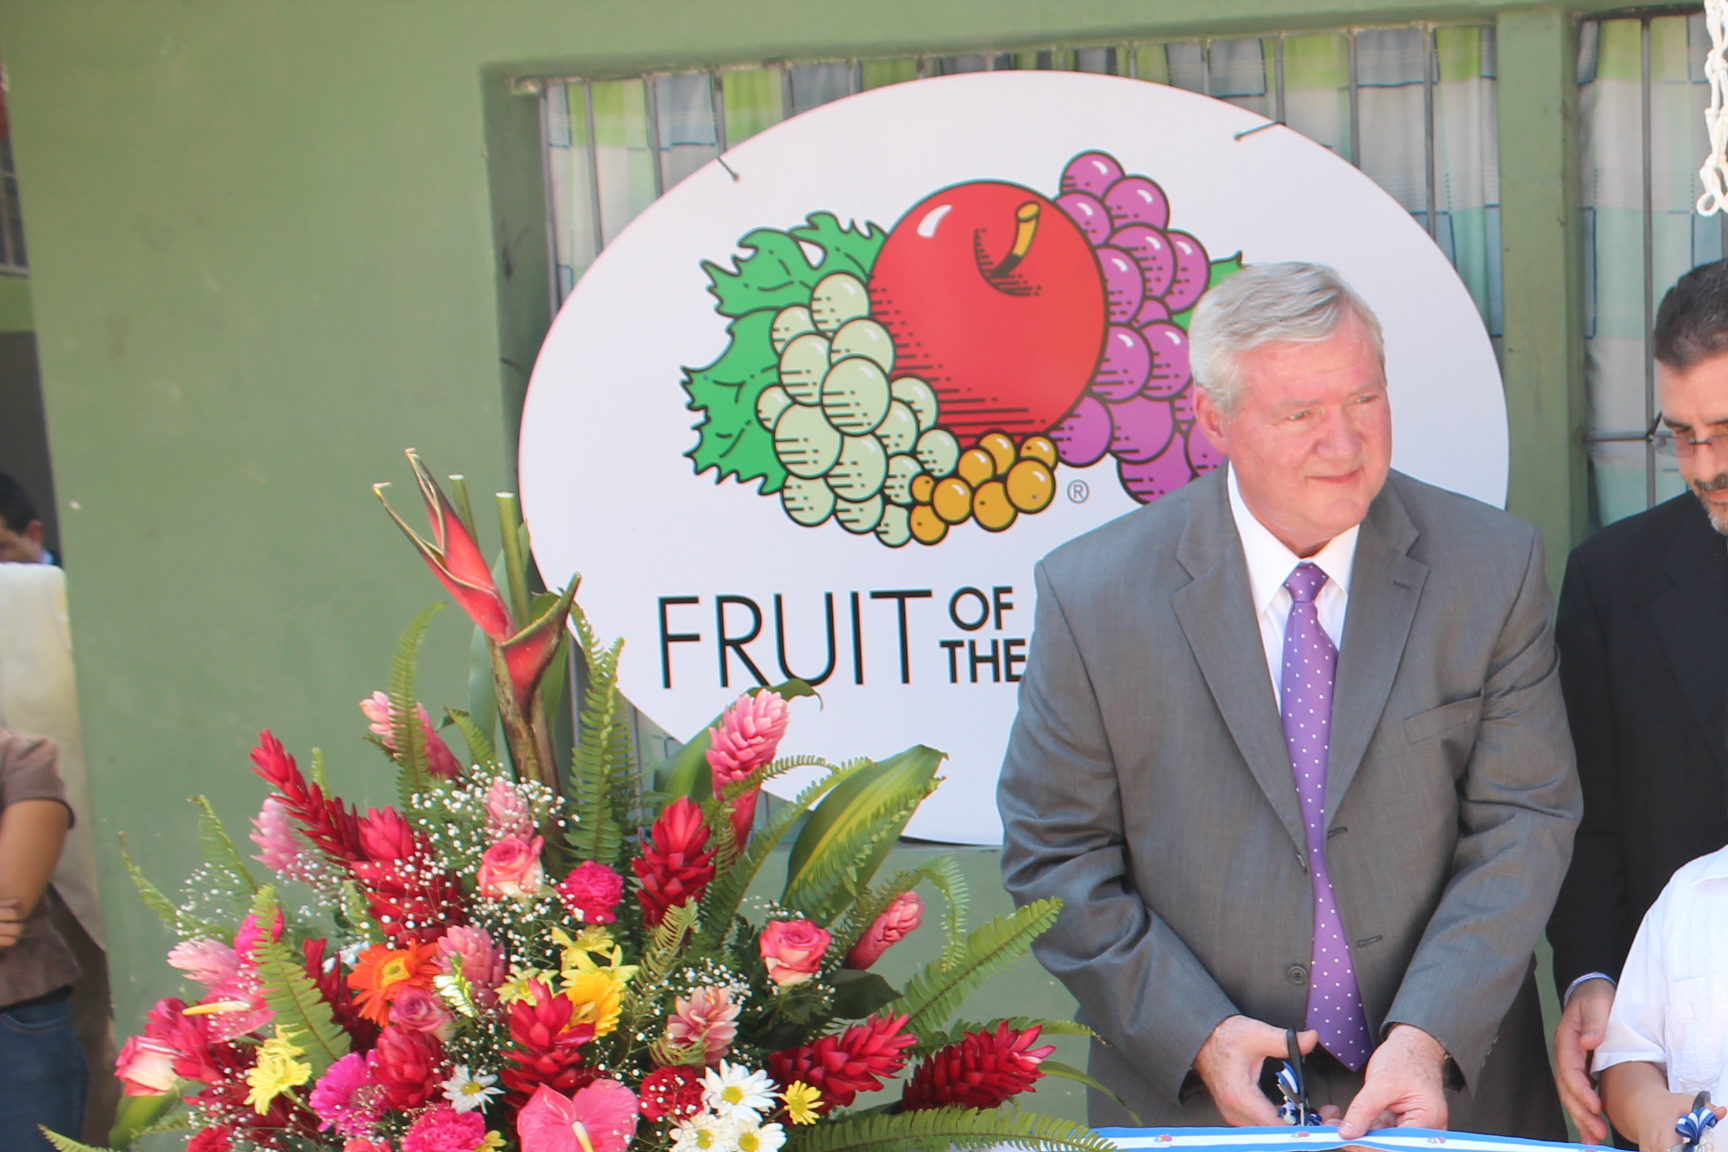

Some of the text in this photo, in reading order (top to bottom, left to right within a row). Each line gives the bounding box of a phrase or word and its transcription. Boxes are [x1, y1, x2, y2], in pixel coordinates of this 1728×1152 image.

[657, 586, 1013, 689] FRUIT OF
[939, 638, 1026, 683] THE
